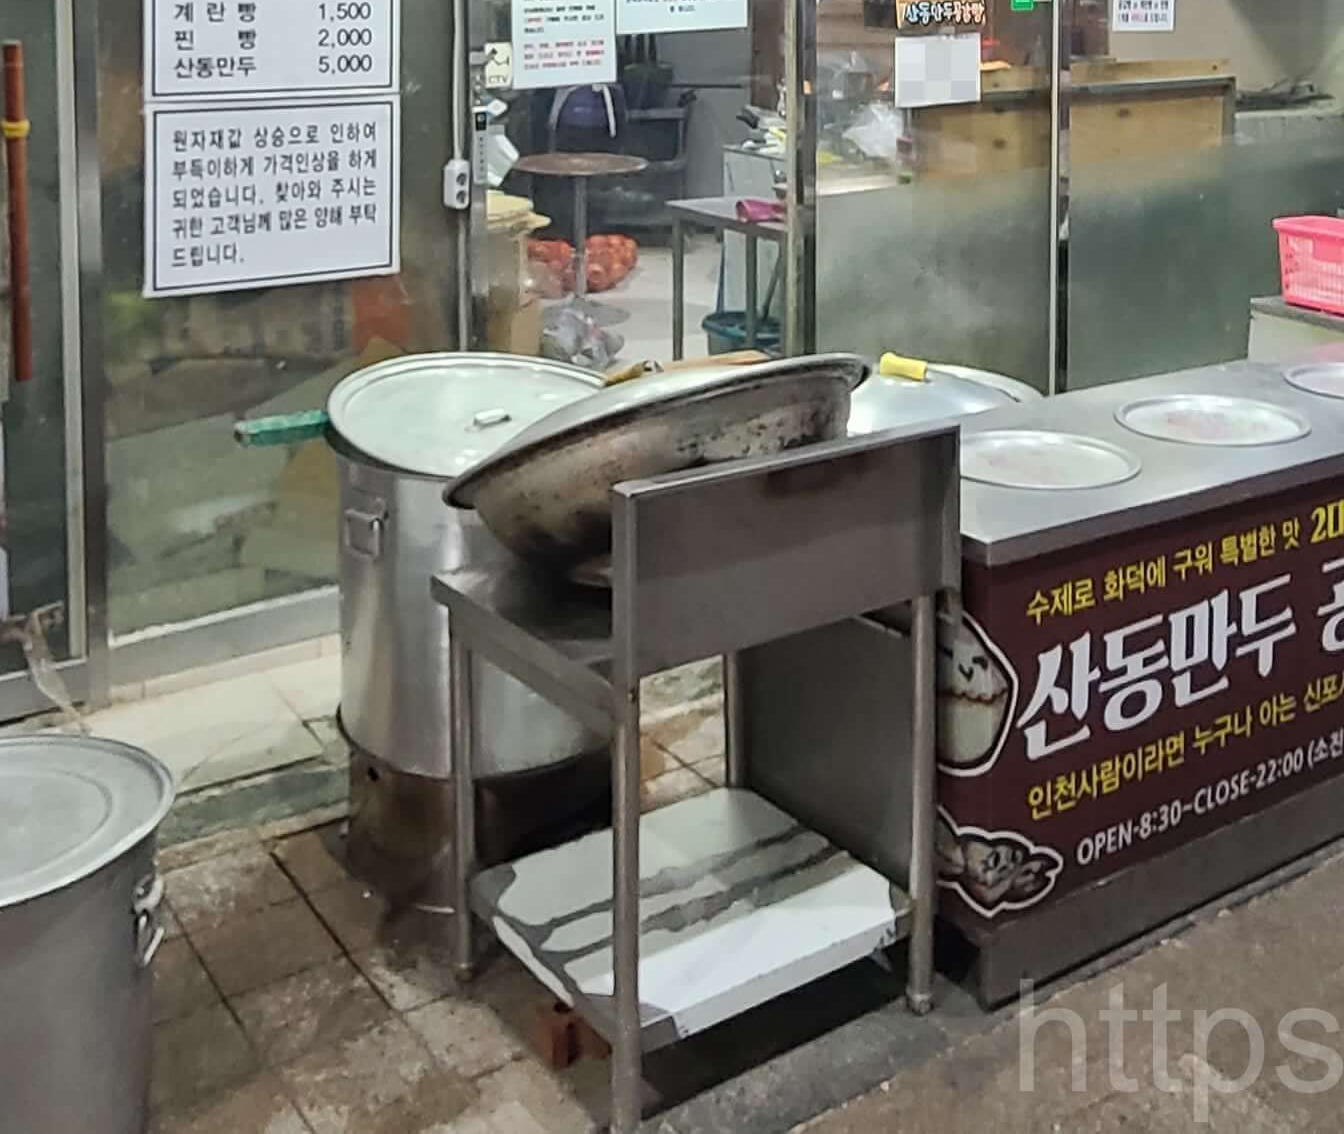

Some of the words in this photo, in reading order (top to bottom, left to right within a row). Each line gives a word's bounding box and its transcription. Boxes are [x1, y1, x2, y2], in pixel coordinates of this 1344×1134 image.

[319, 2, 372, 22] 1,500
[318, 28, 373, 48] 2,000
[174, 56, 257, 79] 산동만두
[318, 55, 373, 75] 5,000
[254, 125, 320, 149] 상승으로
[331, 122, 377, 144] 인하여
[173, 156, 254, 181] 부득이하게
[263, 150, 340, 175] 가격인상을
[349, 149, 377, 170] 하게
[276, 180, 322, 203] 찾아와
[331, 176, 377, 199] 주시는
[315, 206, 343, 228] 양해
[349, 203, 377, 225] 부탁
[1026, 579, 1096, 627] 수제로
[1103, 555, 1166, 603] 화덕에
[1172, 543, 1213, 580] 구워
[1220, 525, 1277, 566] 특별한
[1283, 518, 1301, 551] 맛
[1016, 573, 1297, 760] 산동만두
[1028, 732, 1185, 820] 인천사람이라면
[1193, 705, 1254, 755] 누구나
[1258, 693, 1297, 727] 아는
